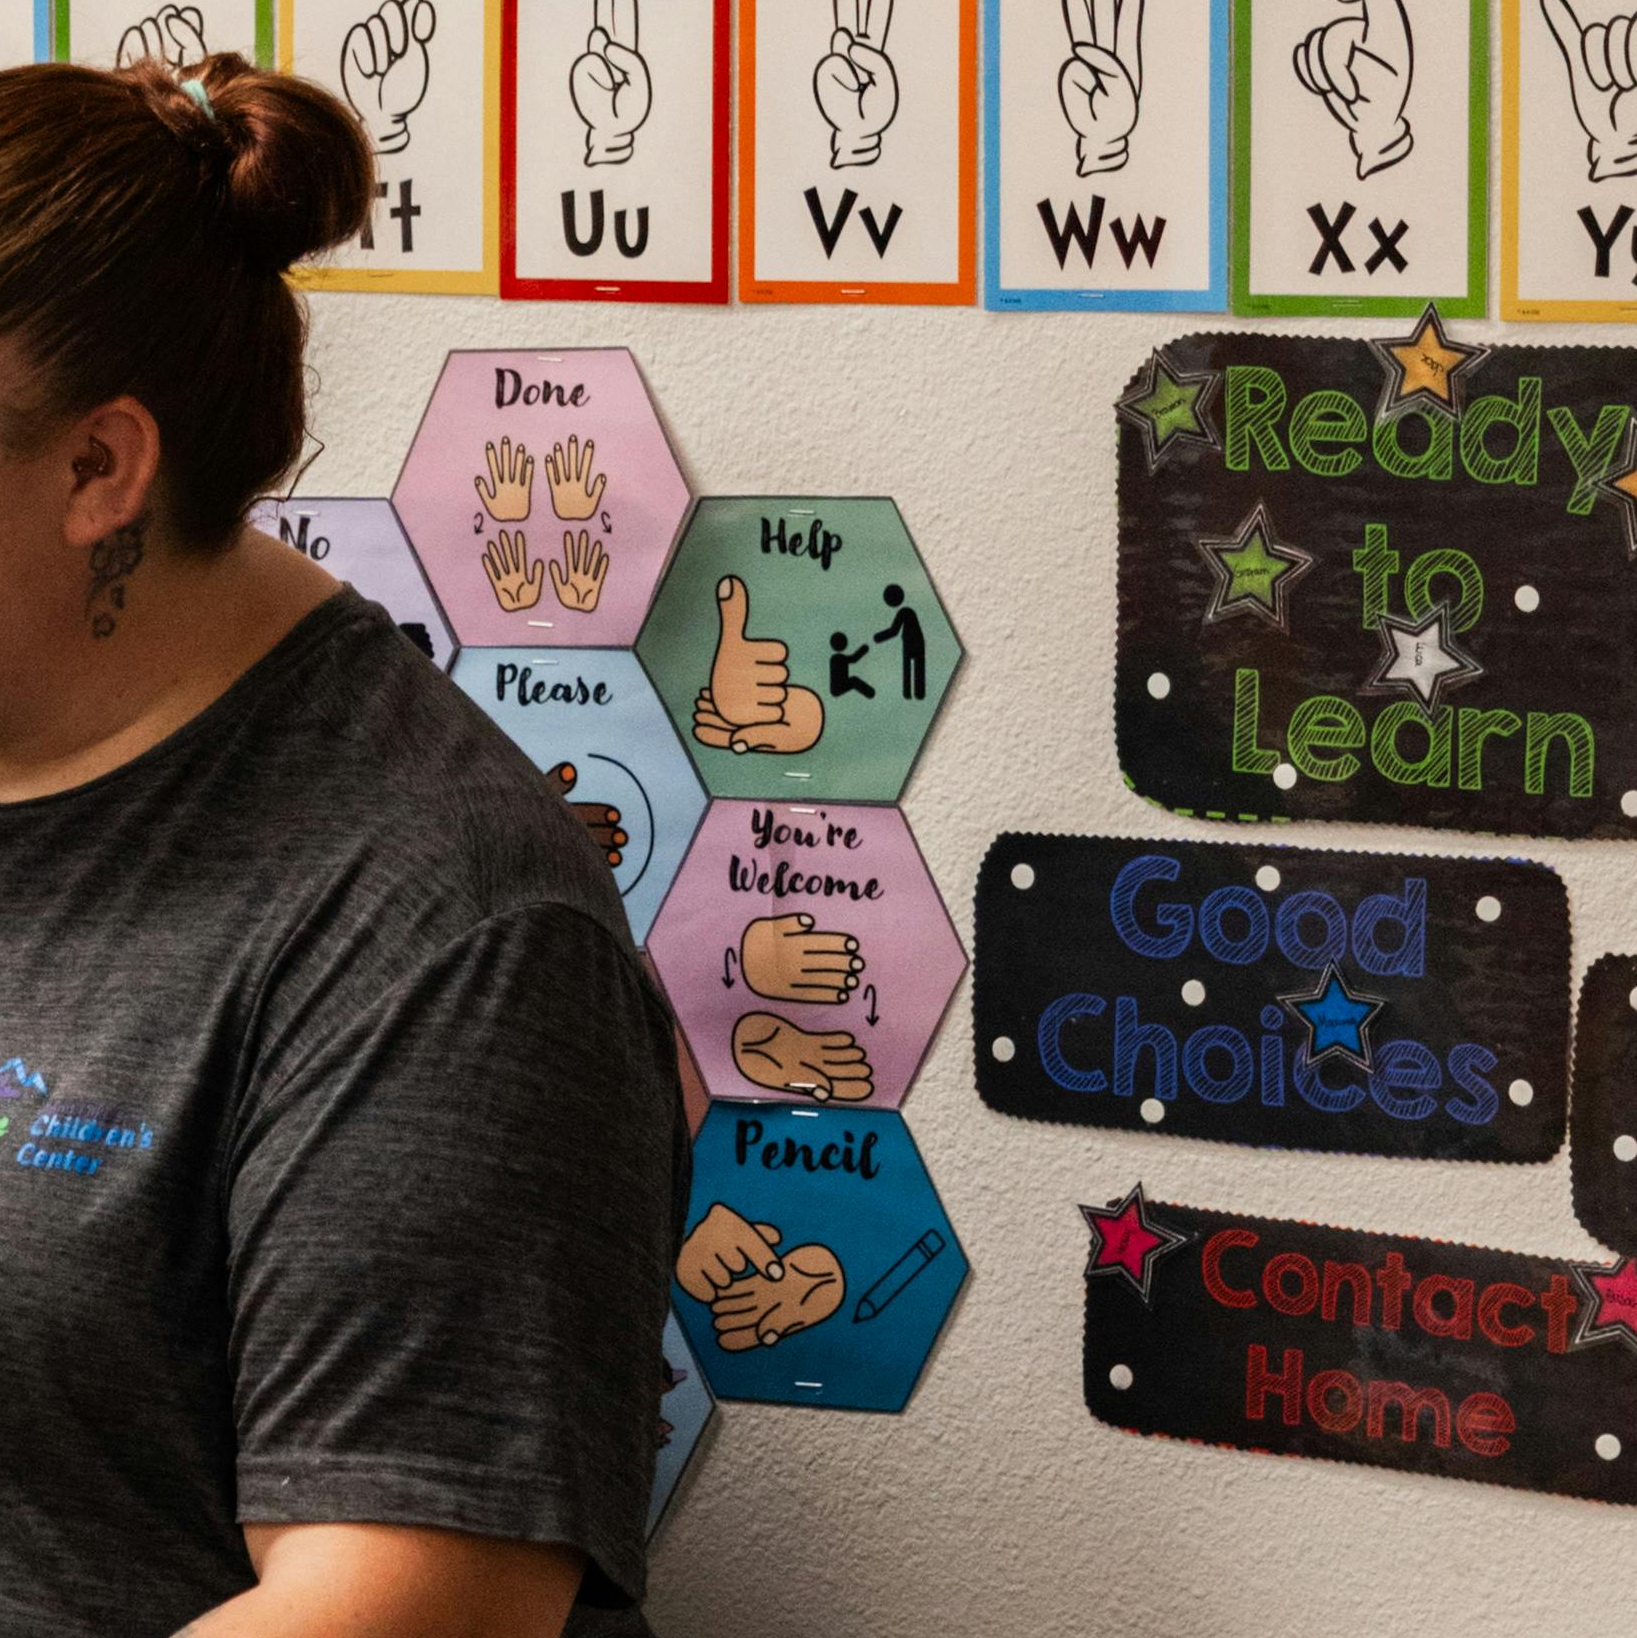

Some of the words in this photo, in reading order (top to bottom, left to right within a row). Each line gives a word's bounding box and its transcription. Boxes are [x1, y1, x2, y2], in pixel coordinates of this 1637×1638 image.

[561, 190, 648, 258] Uu
[804, 187, 903, 259] Vv
[1037, 195, 1166, 269] Ww
[1307, 202, 1409, 275] Xx
[493, 367, 592, 410] Done
[1225, 364, 1632, 516] Ready
[278, 516, 332, 562] No
[760, 517, 844, 571] Help
[1352, 522, 1485, 635] to
[496, 663, 614, 707] Please
[1231, 667, 1596, 799] Learn
[751, 807, 864, 851] You're
[728, 854, 885, 903] Welcome
[1109, 854, 1429, 979] Good
[1036, 991, 1501, 1128] Choices
[16, 1142, 103, 1176] Center
[29, 1114, 155, 1150] Children's
[734, 1118, 883, 1181] Pencil
[1200, 1227, 1579, 1354] Contact
[1245, 1343, 1517, 1458] Home
